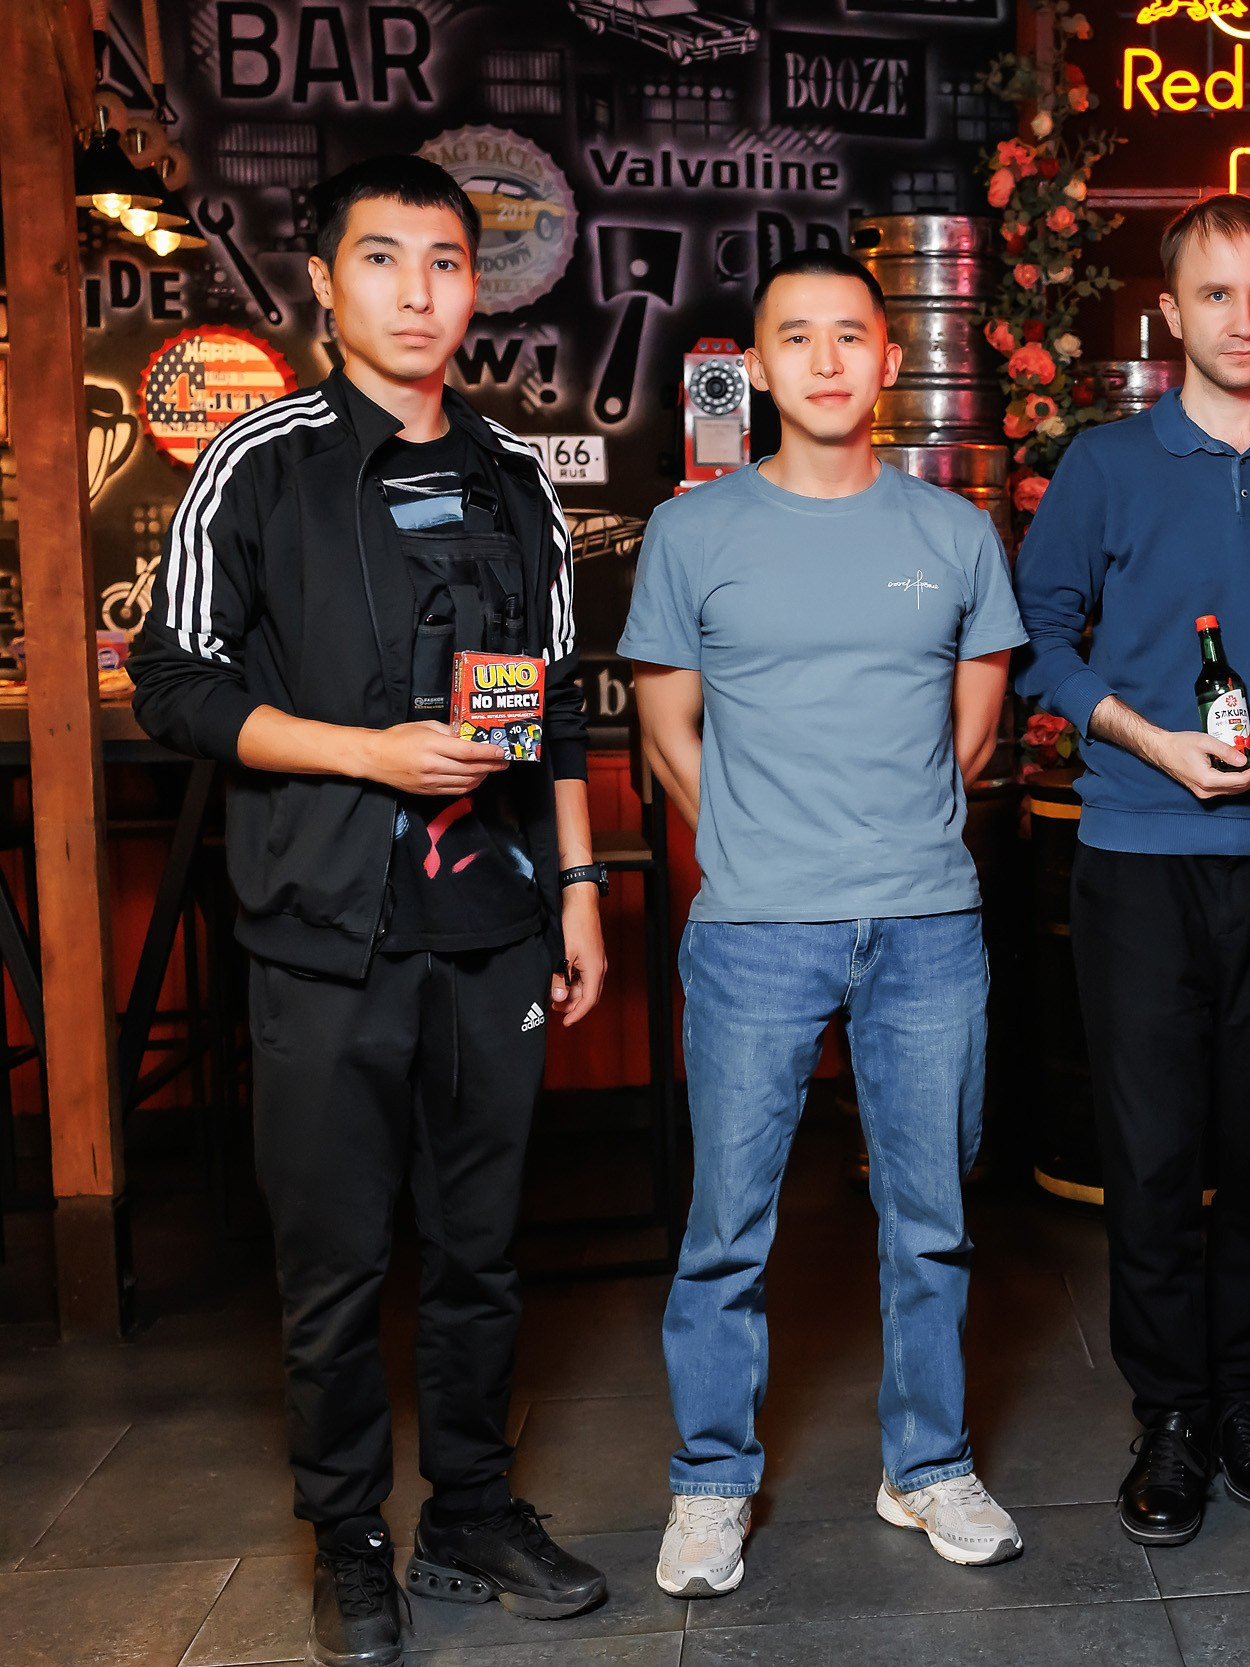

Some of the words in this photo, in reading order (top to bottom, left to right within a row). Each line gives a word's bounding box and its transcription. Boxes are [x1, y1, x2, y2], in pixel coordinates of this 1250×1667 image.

[217, 2, 433, 102] BAR
[785, 51, 909, 117] BOOZE
[1123, 43, 1243, 111] Red
[590, 149, 839, 190] Valvoline
[555, 440, 591, 466] 66
[560, 469, 587, 479] RUS
[473, 662, 538, 692] UNO
[472, 694, 493, 709] NO
[1214, 708, 1247, 720] SAKURA
[521, 1016, 545, 1032] adida
